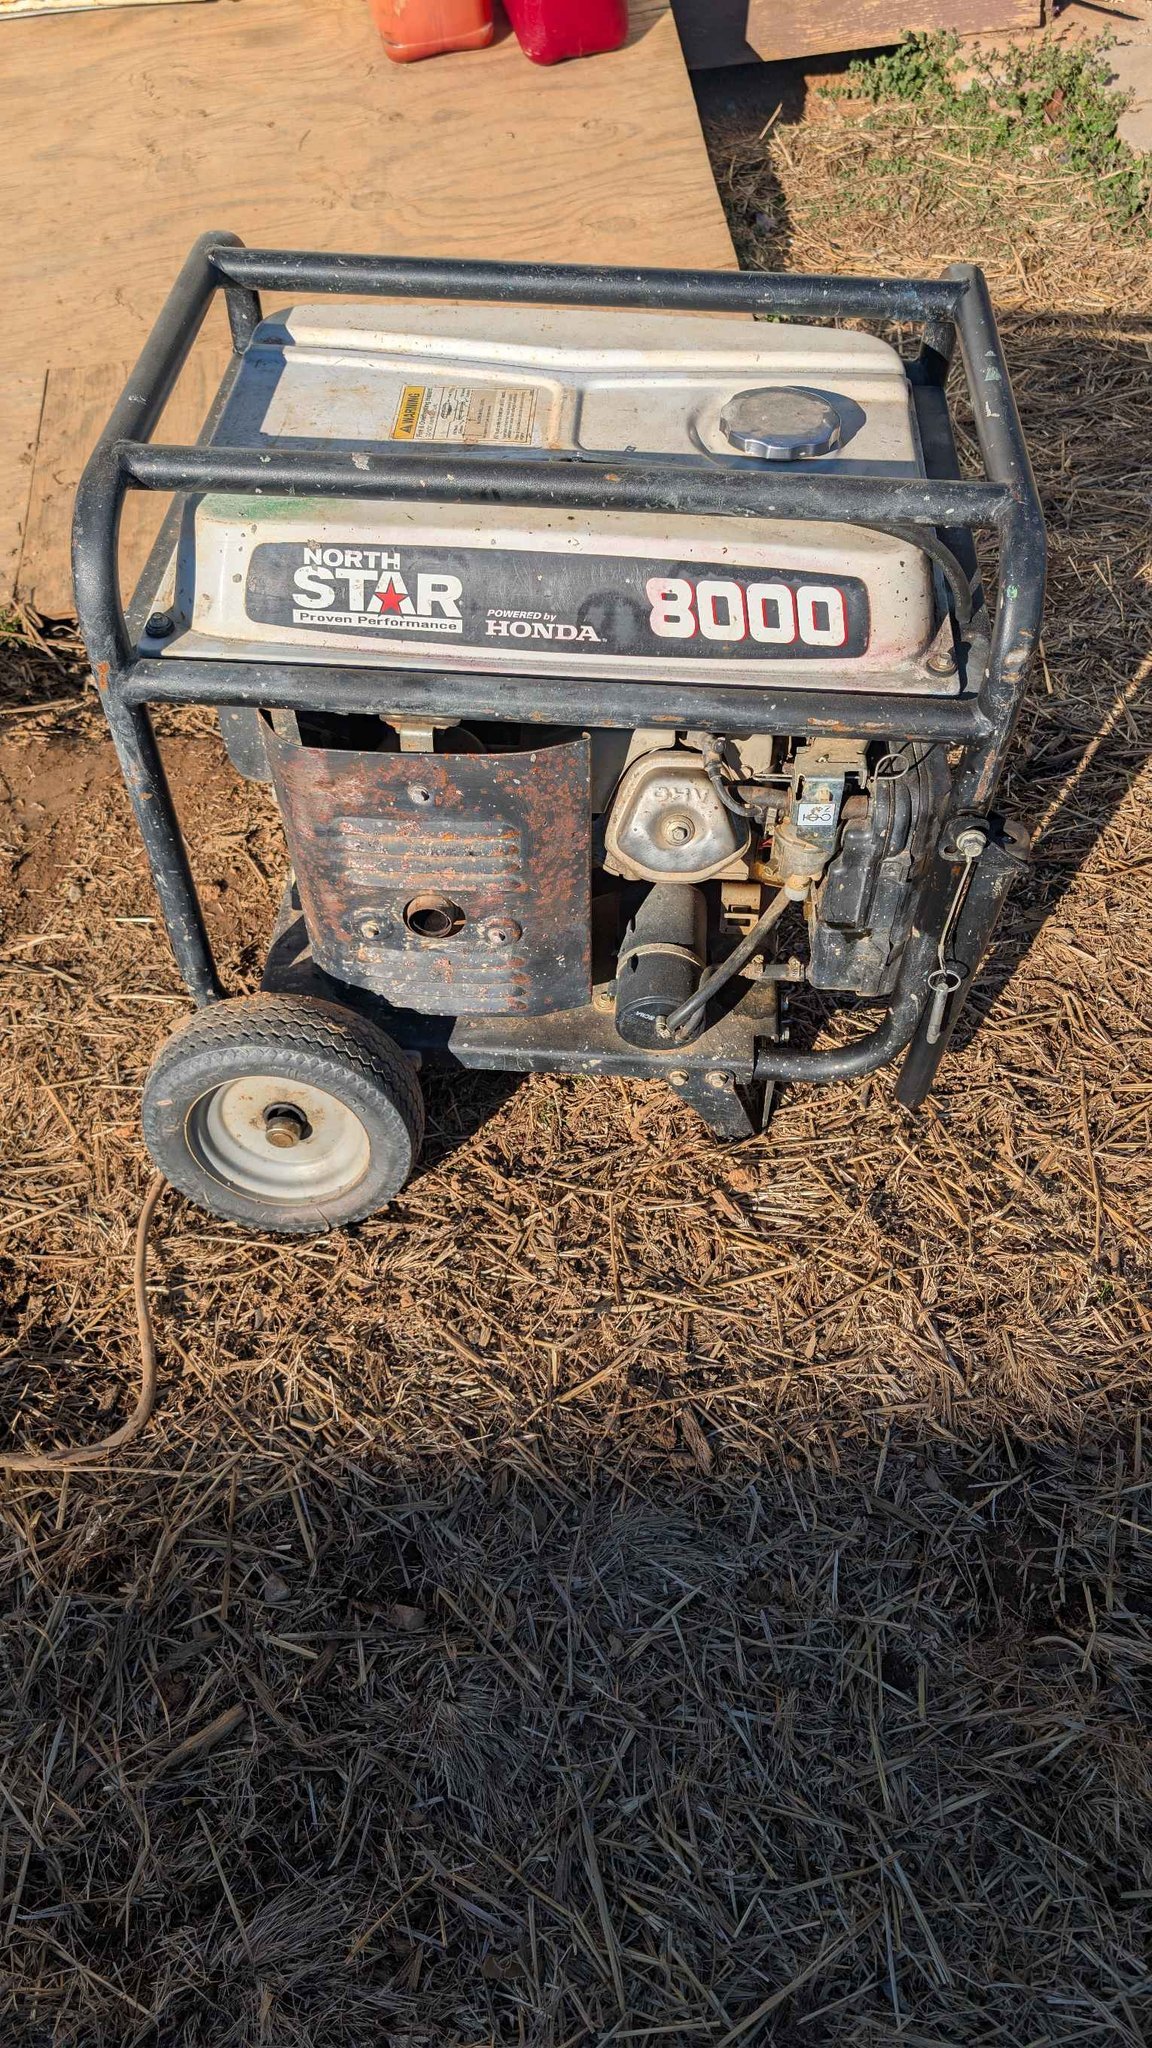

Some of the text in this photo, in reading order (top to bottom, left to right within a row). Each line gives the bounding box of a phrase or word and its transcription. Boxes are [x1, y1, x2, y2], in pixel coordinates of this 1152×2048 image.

[402, 393, 420, 424] WARNING
[303, 547, 400, 570] NORTH
[292, 566, 463, 618] STAR
[299, 612, 458, 630] Proven Performance
[487, 609, 556, 622] POWERED by
[646, 577, 848, 647] 8000
[485, 620, 601, 642] HONDA
